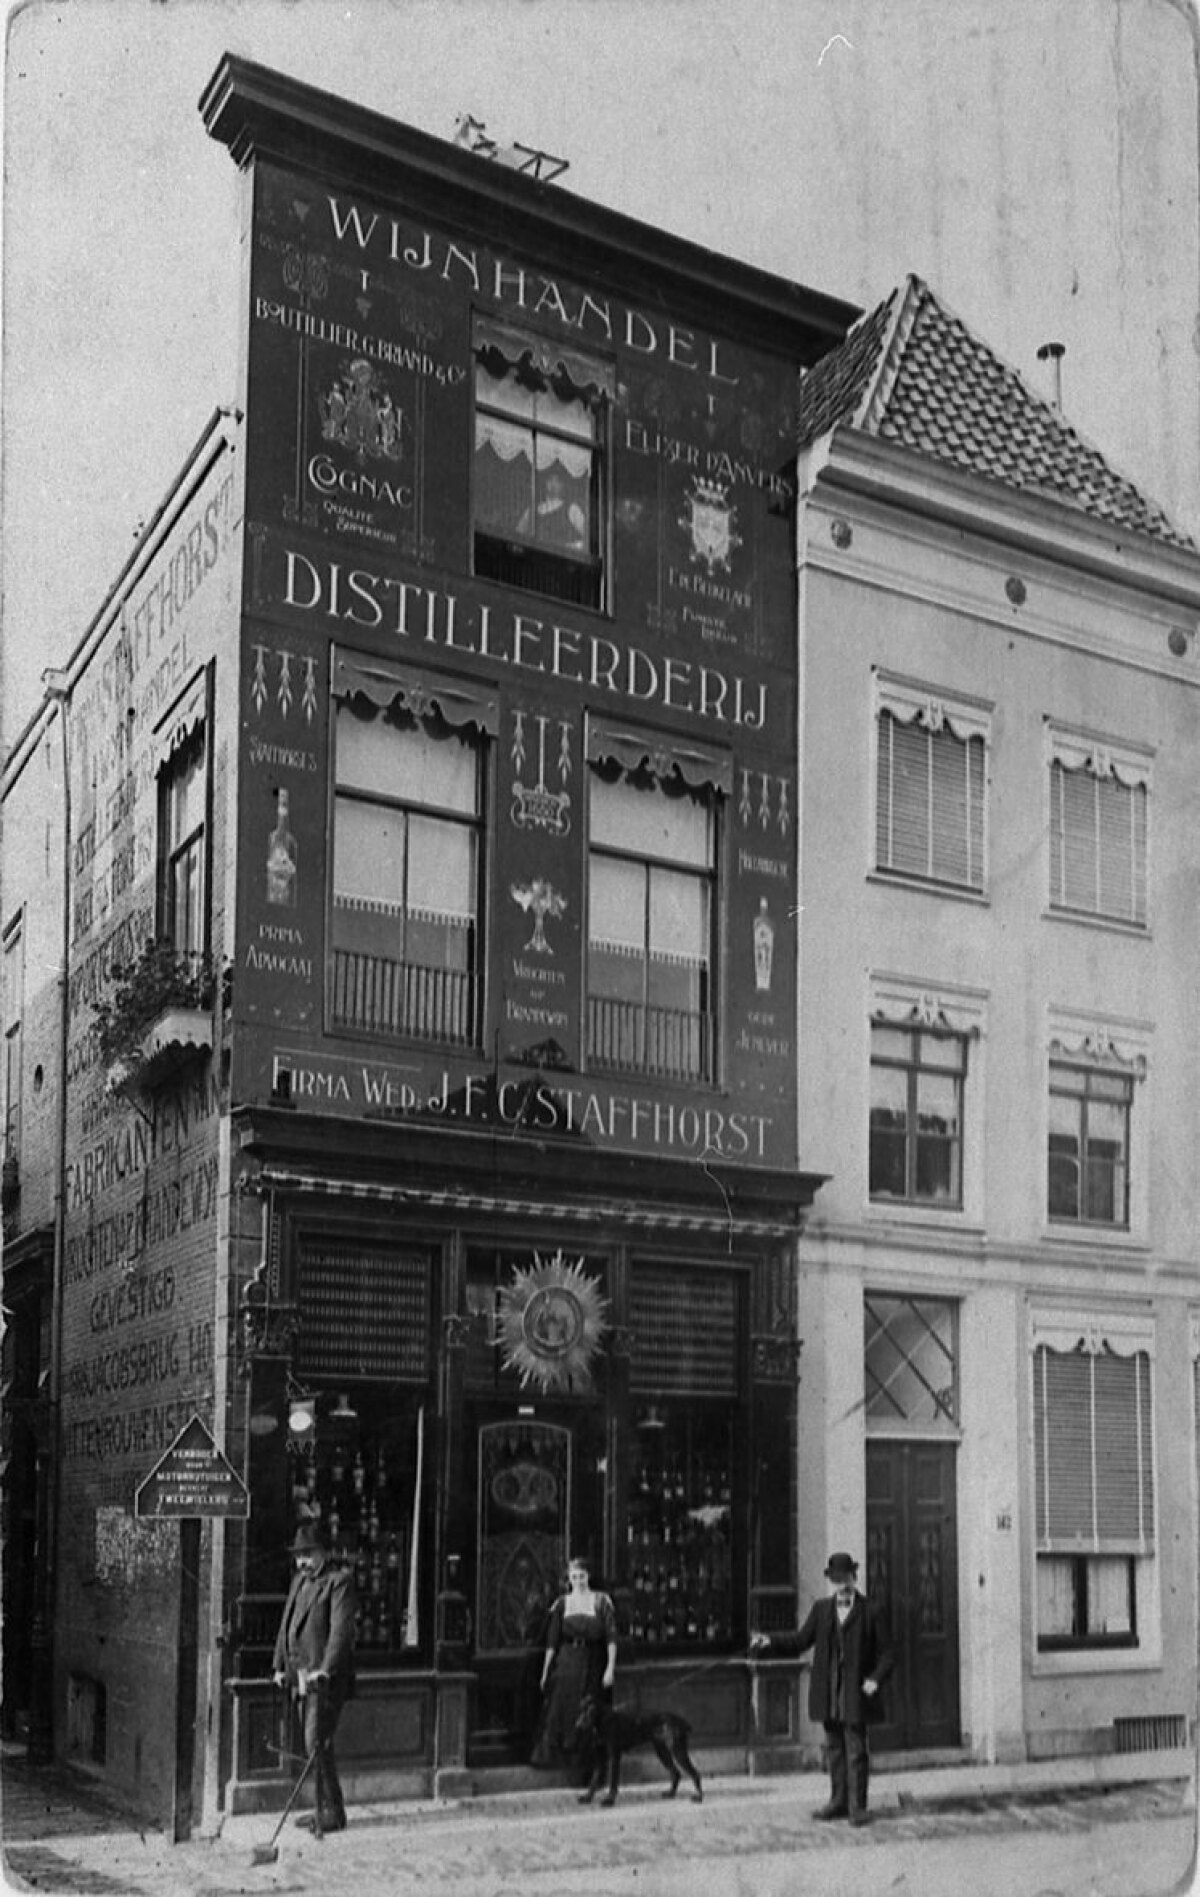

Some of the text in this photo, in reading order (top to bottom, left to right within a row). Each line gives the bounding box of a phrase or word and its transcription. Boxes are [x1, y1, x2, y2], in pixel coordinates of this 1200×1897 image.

[327, 196, 739, 386] WIJNHANDEL
[308, 453, 412, 508] COGNAC
[283, 550, 768, 729] DISTILLEERDERIJ
[272, 1054, 351, 1101] FIRMA
[535, 1086, 774, 1157] STAFFHORST
